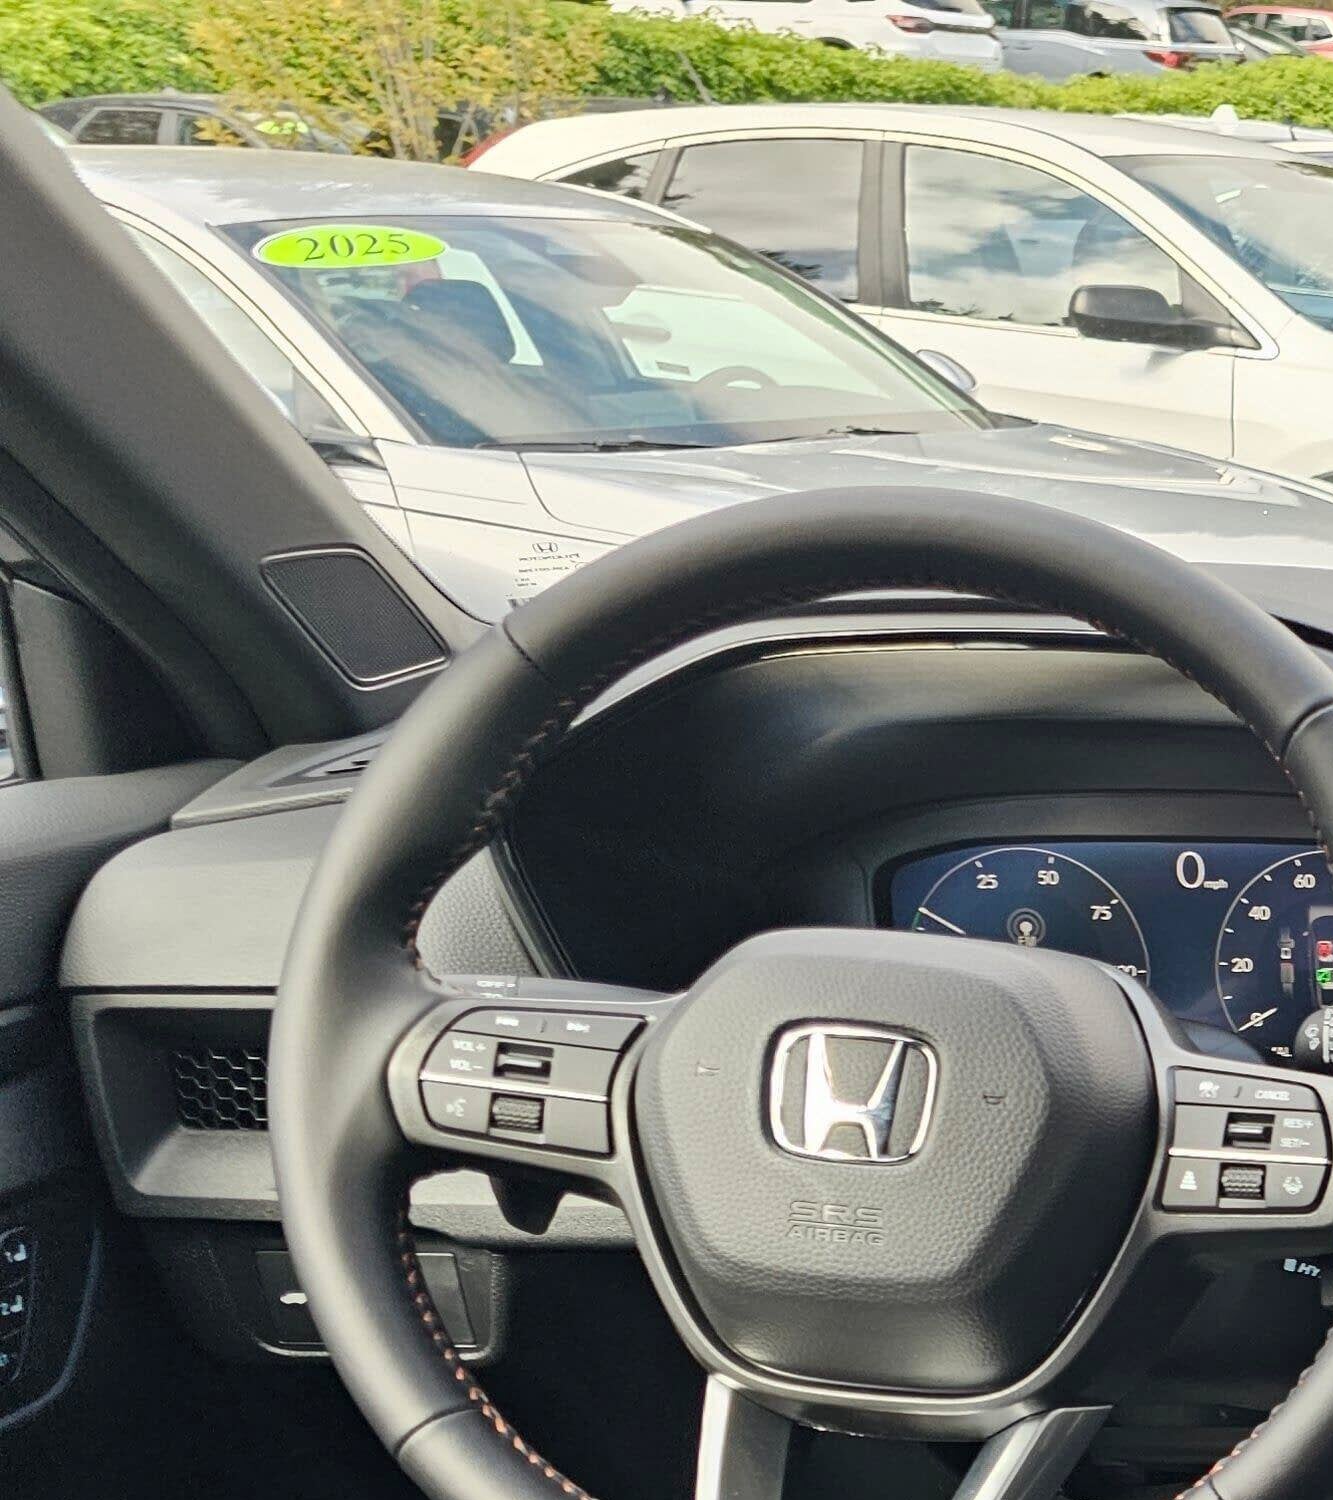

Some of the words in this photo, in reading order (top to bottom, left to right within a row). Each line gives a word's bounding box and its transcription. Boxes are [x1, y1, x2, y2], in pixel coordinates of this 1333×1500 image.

[296, 233, 411, 262] 2025
[1037, 870, 1060, 885] 50
[1176, 851, 1205, 888] 0
[976, 874, 998, 889] 25
[1293, 874, 1316, 888] 60
[1090, 905, 1113, 921] 75
[1248, 905, 1271, 921] 40
[1230, 957, 1254, 973] 20
[789, 1200, 884, 1226] SRS
[785, 1224, 885, 1246] AIRBAG
